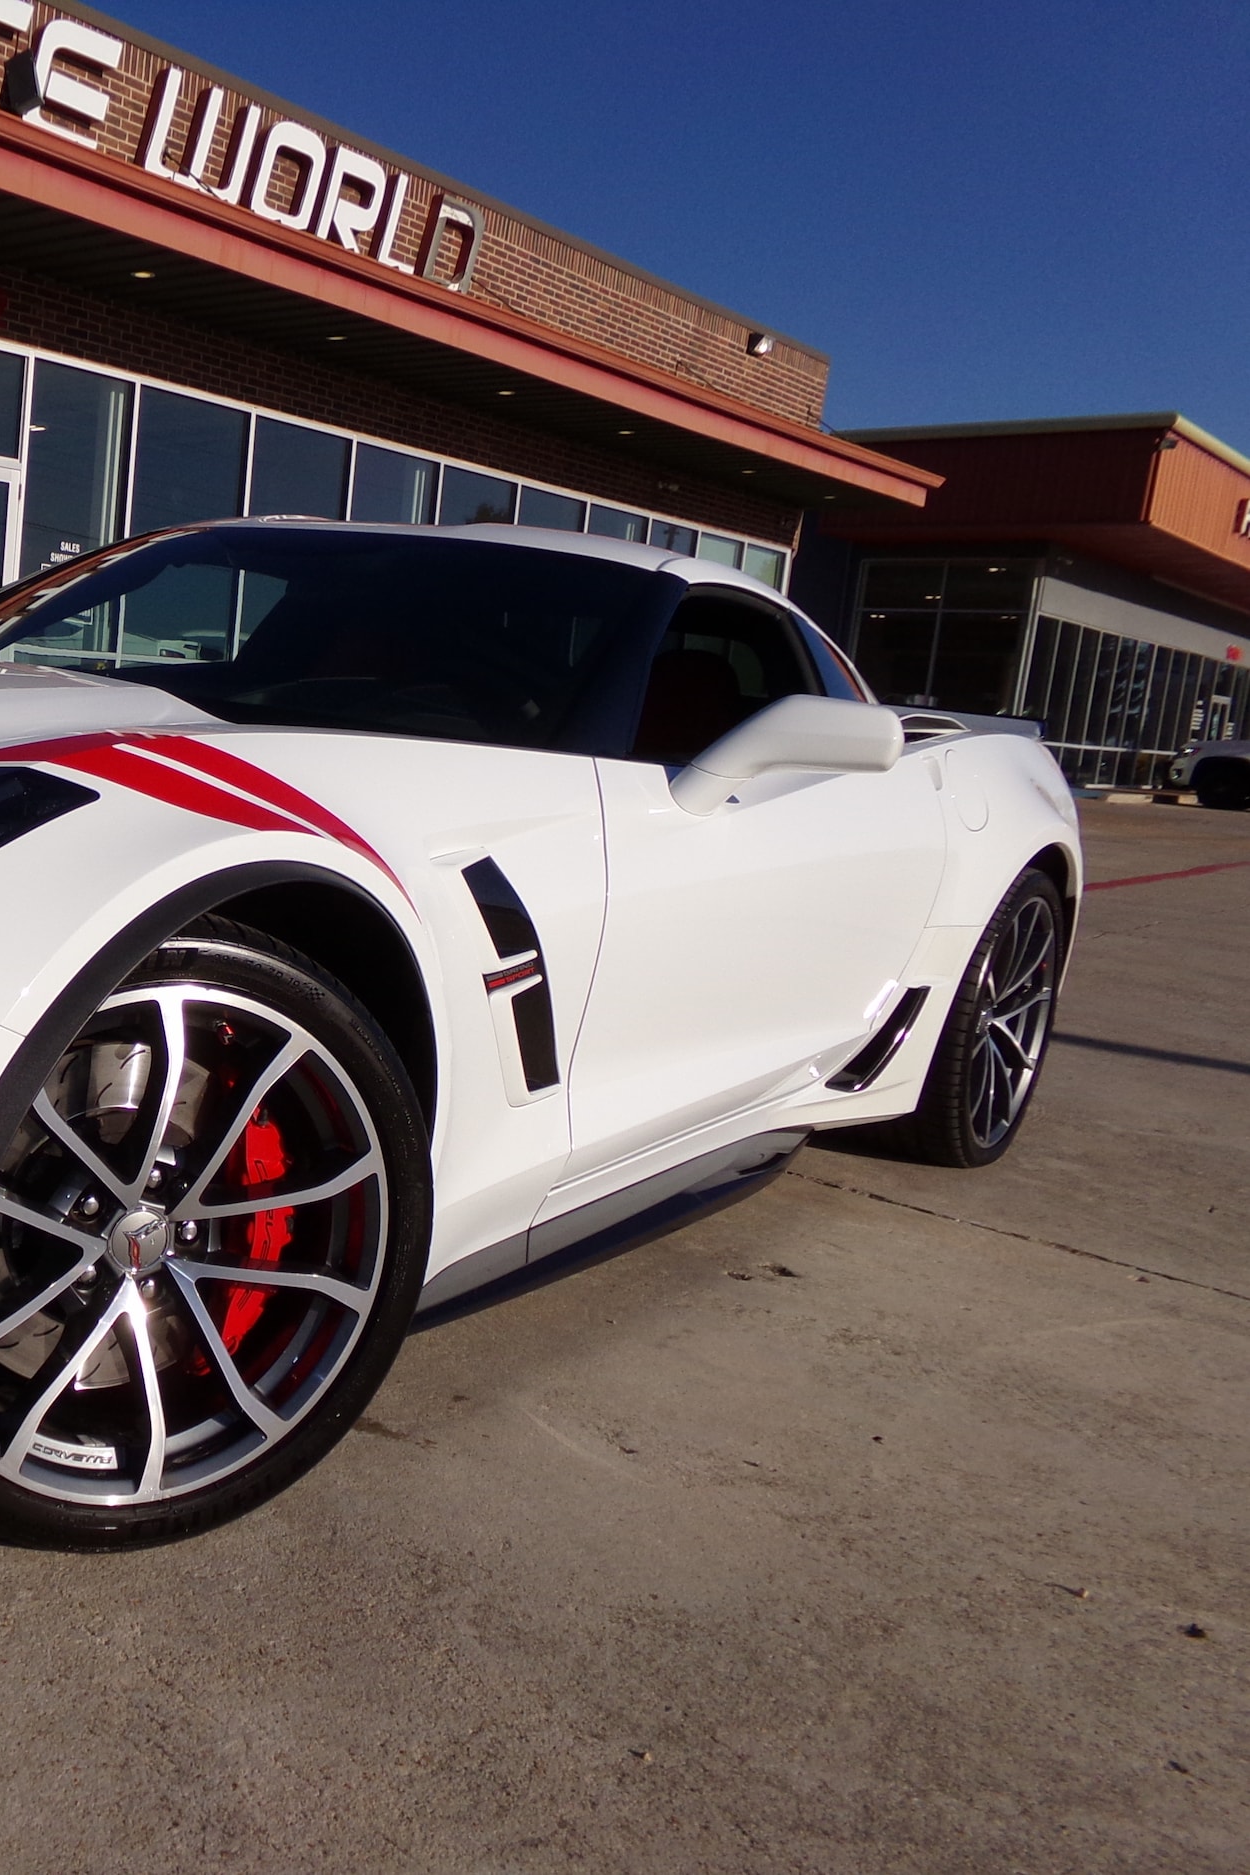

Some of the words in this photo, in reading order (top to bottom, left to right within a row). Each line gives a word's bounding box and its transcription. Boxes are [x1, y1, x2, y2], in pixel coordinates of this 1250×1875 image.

[144, 66, 486, 294] WORLD
[60, 541, 81, 553] SALES
[31, 1442, 113, 1465] CORVETTE
